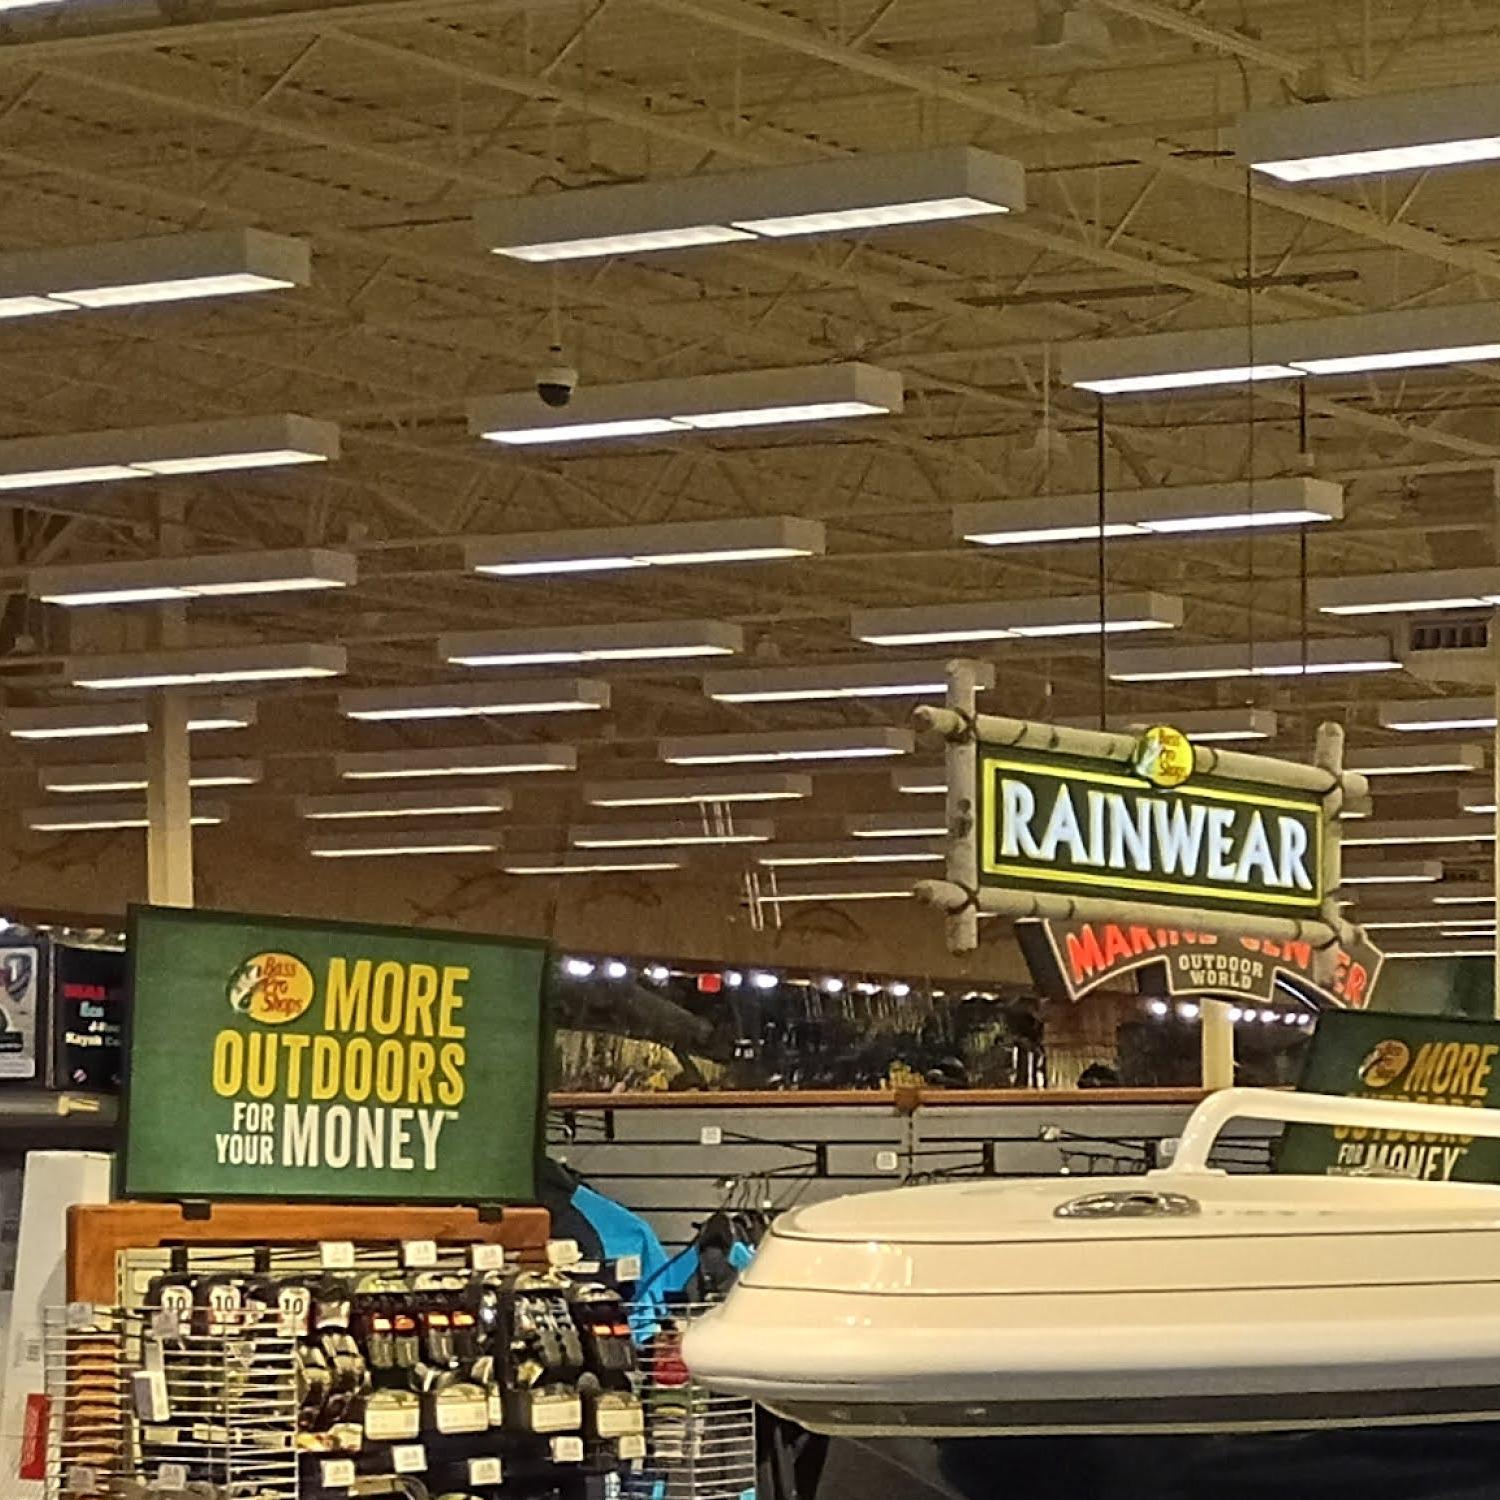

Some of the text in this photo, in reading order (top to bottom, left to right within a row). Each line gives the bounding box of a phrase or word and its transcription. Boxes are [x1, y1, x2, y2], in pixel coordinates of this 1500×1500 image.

[1000, 779, 1313, 891] RAINWEAR
[1178, 954, 1264, 979] OUTDOOR
[1190, 970, 1253, 989] WORLD
[323, 957, 470, 1039] MORE
[212, 1029, 466, 1106] OUTDOORS
[1403, 1041, 1500, 1096] MORE
[233, 1102, 275, 1134] FOR
[215, 1133, 275, 1165] YOUR
